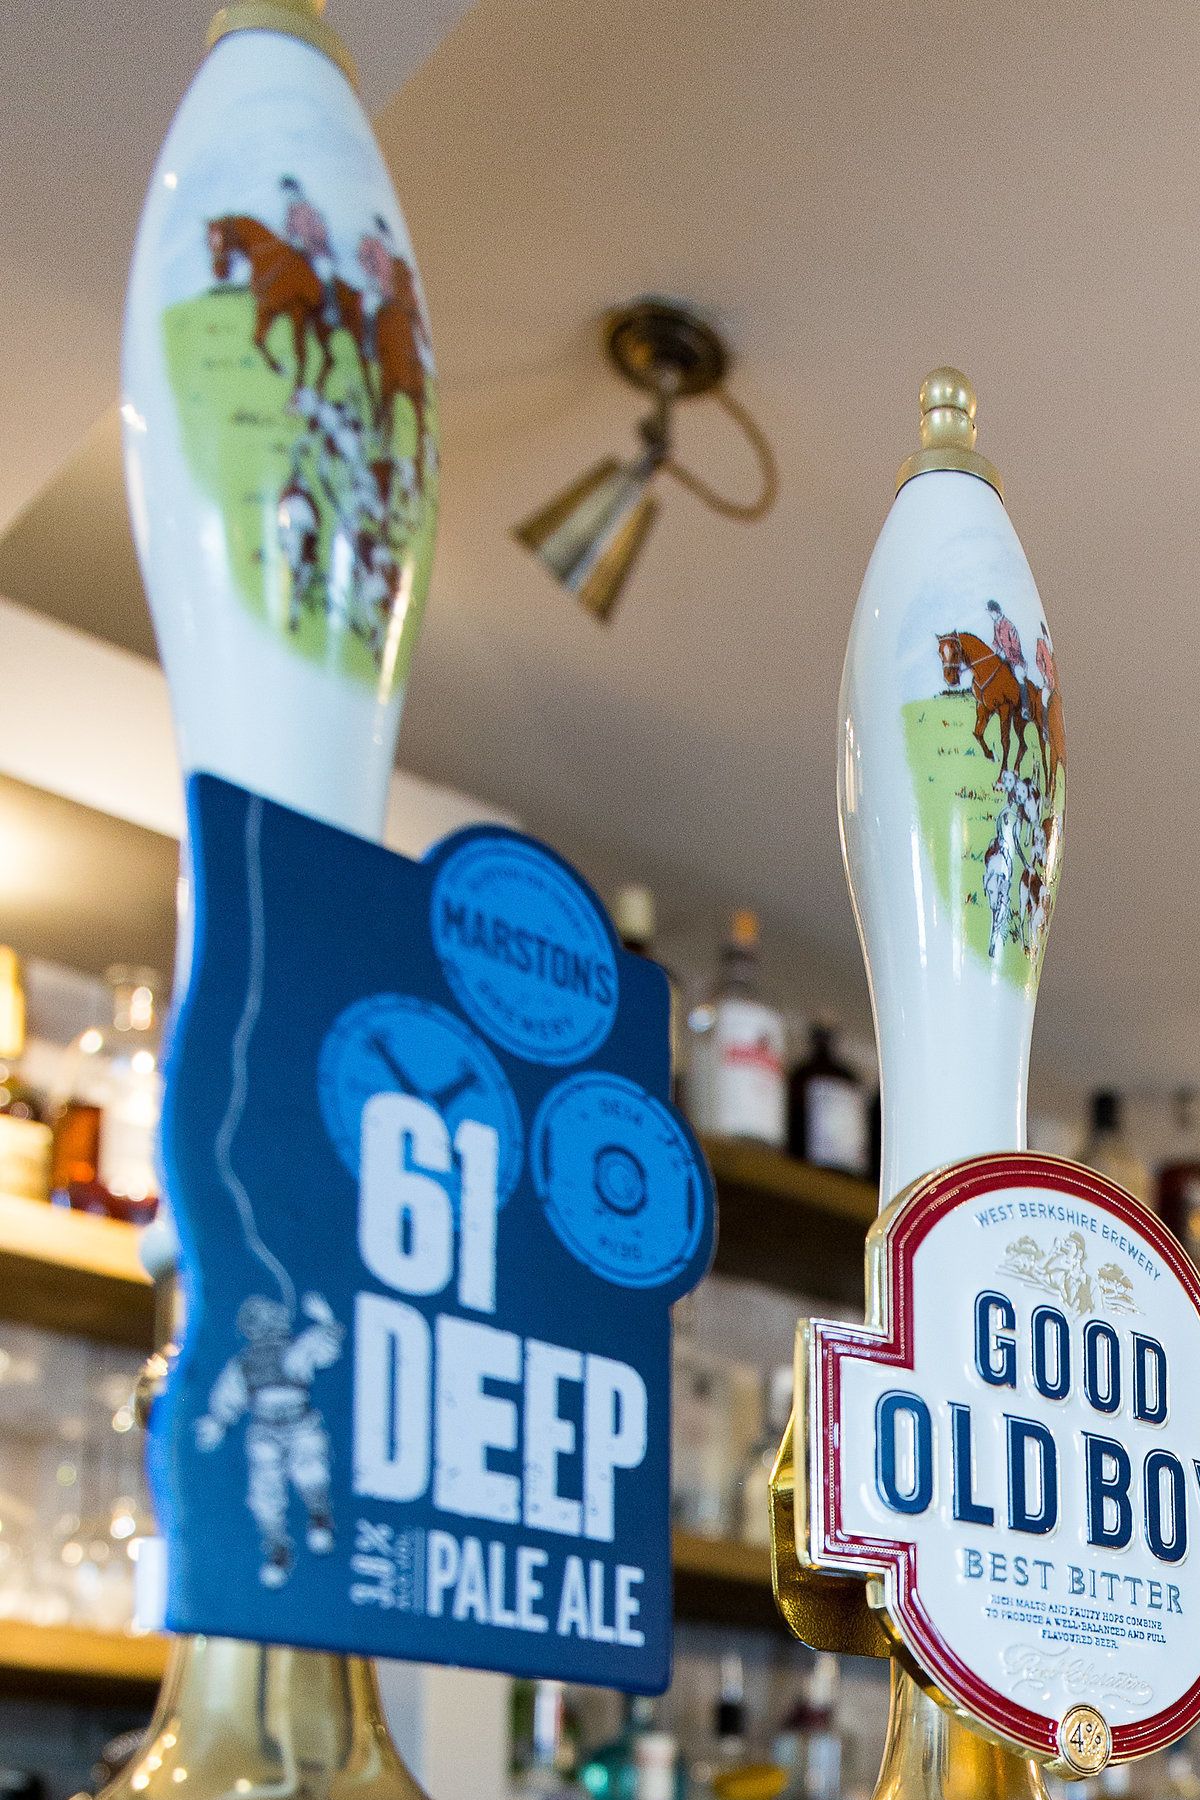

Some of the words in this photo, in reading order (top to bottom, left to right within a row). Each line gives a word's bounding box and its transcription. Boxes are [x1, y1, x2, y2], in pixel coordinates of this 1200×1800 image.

[358, 1091, 499, 1312] 61
[976, 1203, 1014, 1228] WEST
[1018, 1203, 1098, 1234] BERKSHIRE
[1101, 1224, 1161, 1282] BREWERY
[974, 1289, 1168, 1424] GOOD
[352, 1290, 648, 1543] DEEP
[875, 1390, 1058, 1535] OLD
[427, 1528, 549, 1633] PALE
[556, 1554, 646, 1647] ALE
[964, 1548, 1055, 1590] BEST
[1067, 1565, 1184, 1615] BITTER
[990, 1594, 1014, 1607] RICH
[1015, 1598, 1047, 1612] MALTS
[1049, 1603, 1067, 1615] AND
[1069, 1606, 1101, 1620] FRUITY
[1102, 1611, 1124, 1624] HOPS
[1126, 1616, 1163, 1630] COMBINE
[985, 1606, 998, 1618] TO
[1001, 1609, 1044, 1625] PRODUCE
[1045, 1615, 1052, 1625] A
[1054, 1617, 1127, 1637] WELL-BALANCED
[1127, 1628, 1145, 1640] AND
[1146, 1631, 1167, 1644] FULL
[1041, 1628, 1093, 1645] FLAVOURED
[1069, 1721, 1102, 1752] 4%
